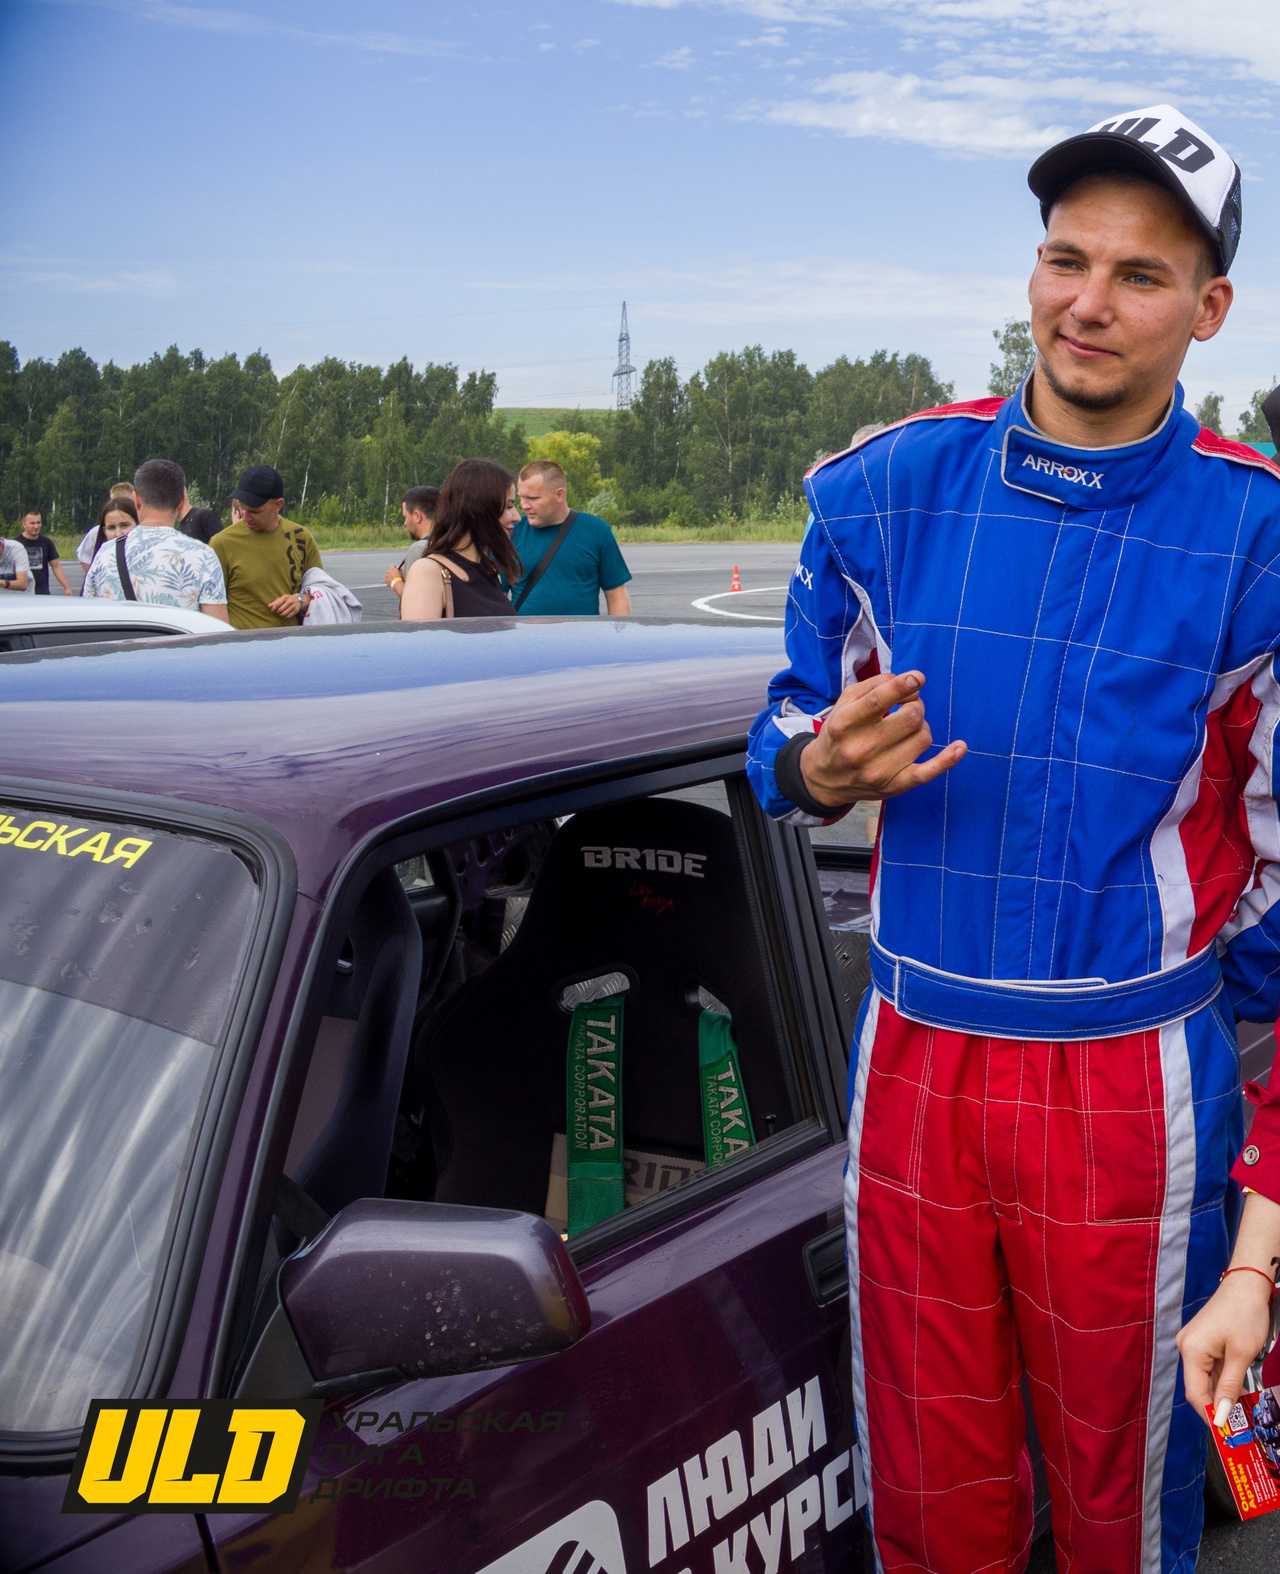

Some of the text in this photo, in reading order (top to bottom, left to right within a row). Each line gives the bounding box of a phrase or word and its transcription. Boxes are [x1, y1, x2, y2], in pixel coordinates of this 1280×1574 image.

[1022, 454, 1105, 490] ARROXX
[0, 814, 153, 869] ЬСКАЯ
[574, 1064, 588, 1149] CORPORATION
[586, 1014, 616, 1151] TAKATA
[706, 1074, 719, 1117] TAKATA
[647, 1375, 828, 1568] ЛЮДИ
[1227, 1457, 1250, 1512] Опарин
[713, 1444, 868, 1574] КУРС
